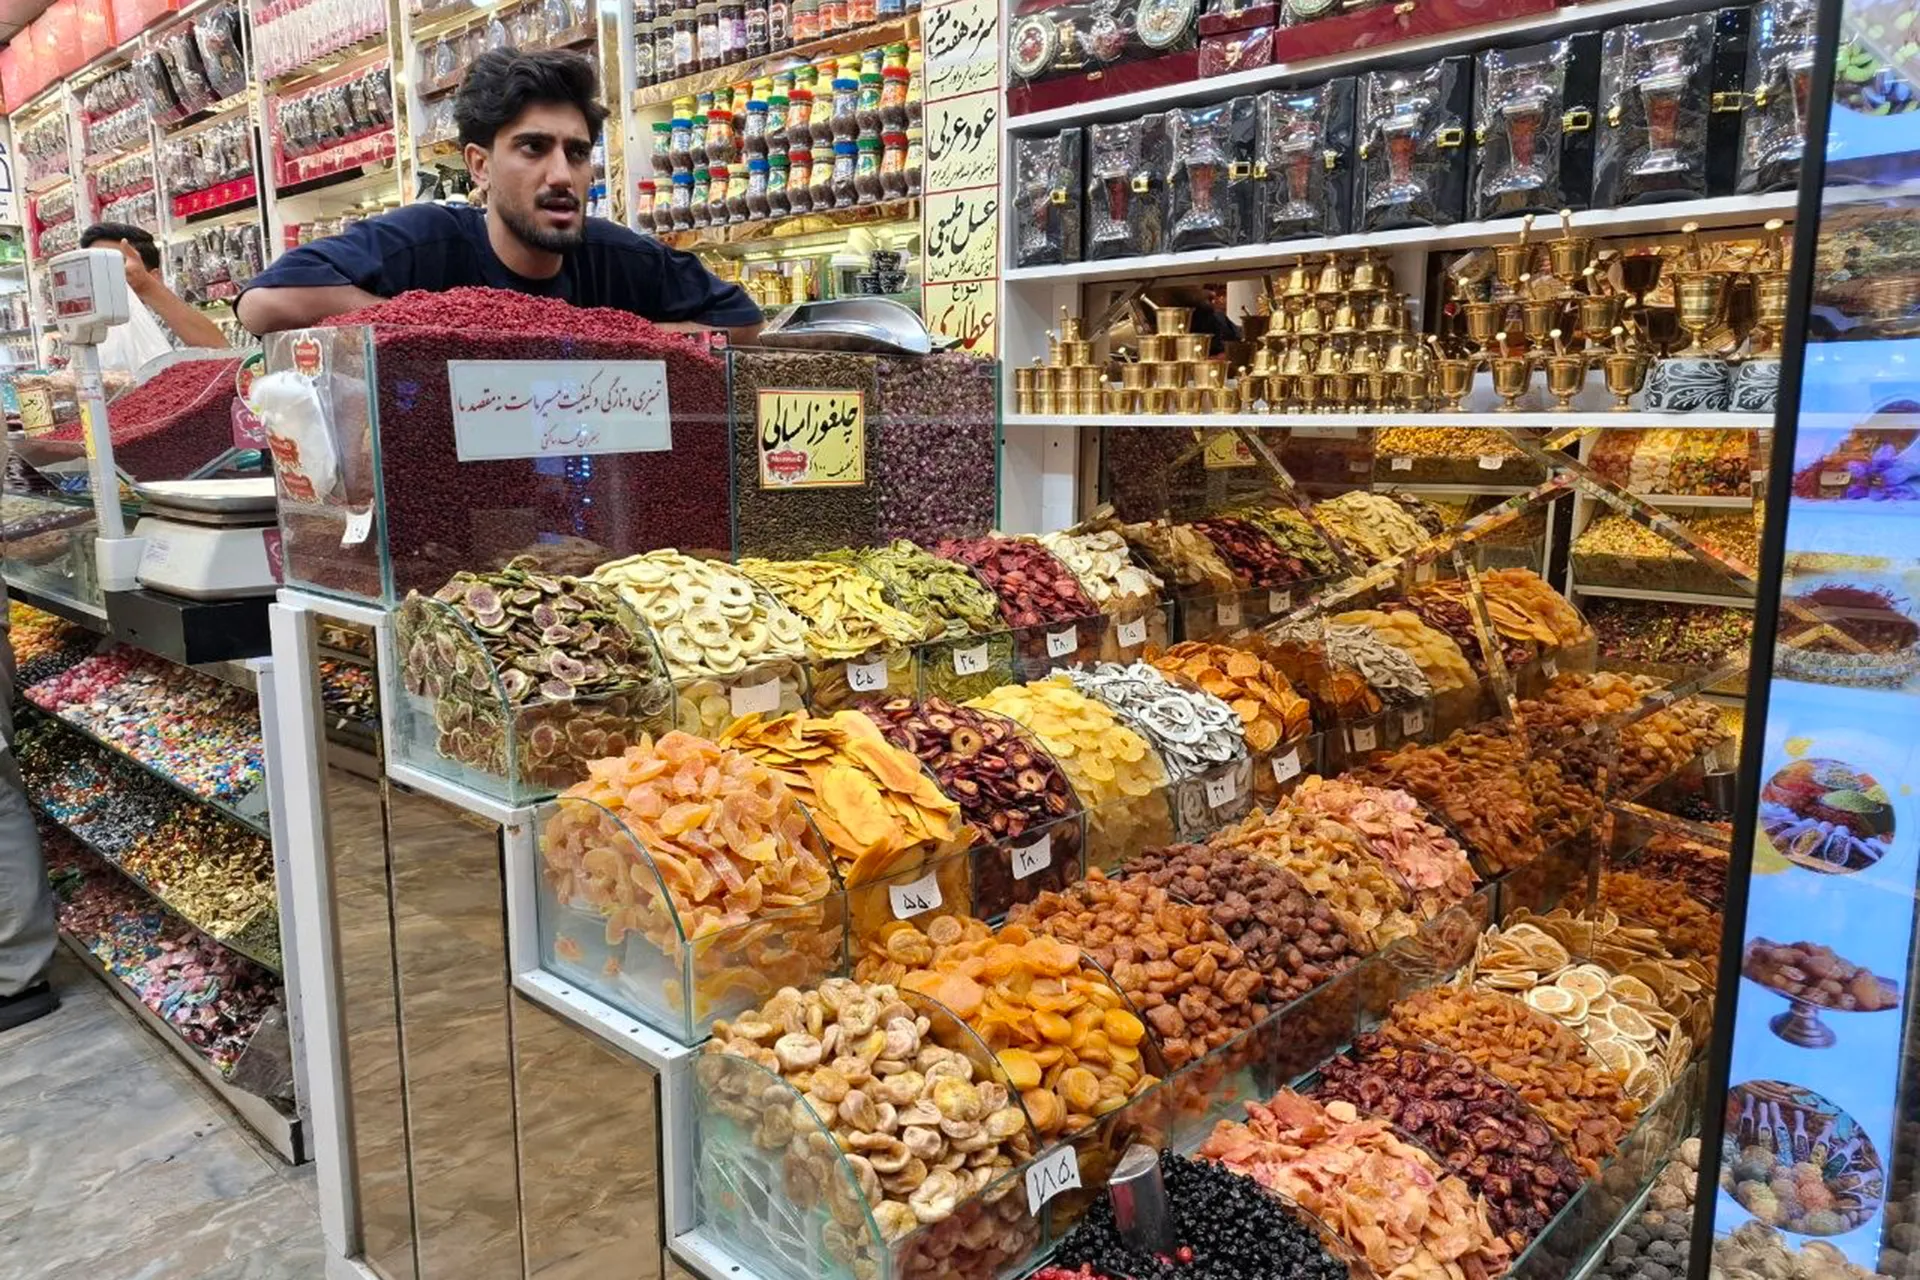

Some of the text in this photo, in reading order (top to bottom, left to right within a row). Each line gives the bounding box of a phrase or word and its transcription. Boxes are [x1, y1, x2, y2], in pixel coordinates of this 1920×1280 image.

[928, 110, 968, 163] عربی
[928, 194, 998, 259] عسل طبیعی
[952, 281, 984, 302] انواع
[457, 395, 465, 412] ما
[557, 368, 604, 413] کیفیت
[601, 376, 628, 413] تازگی
